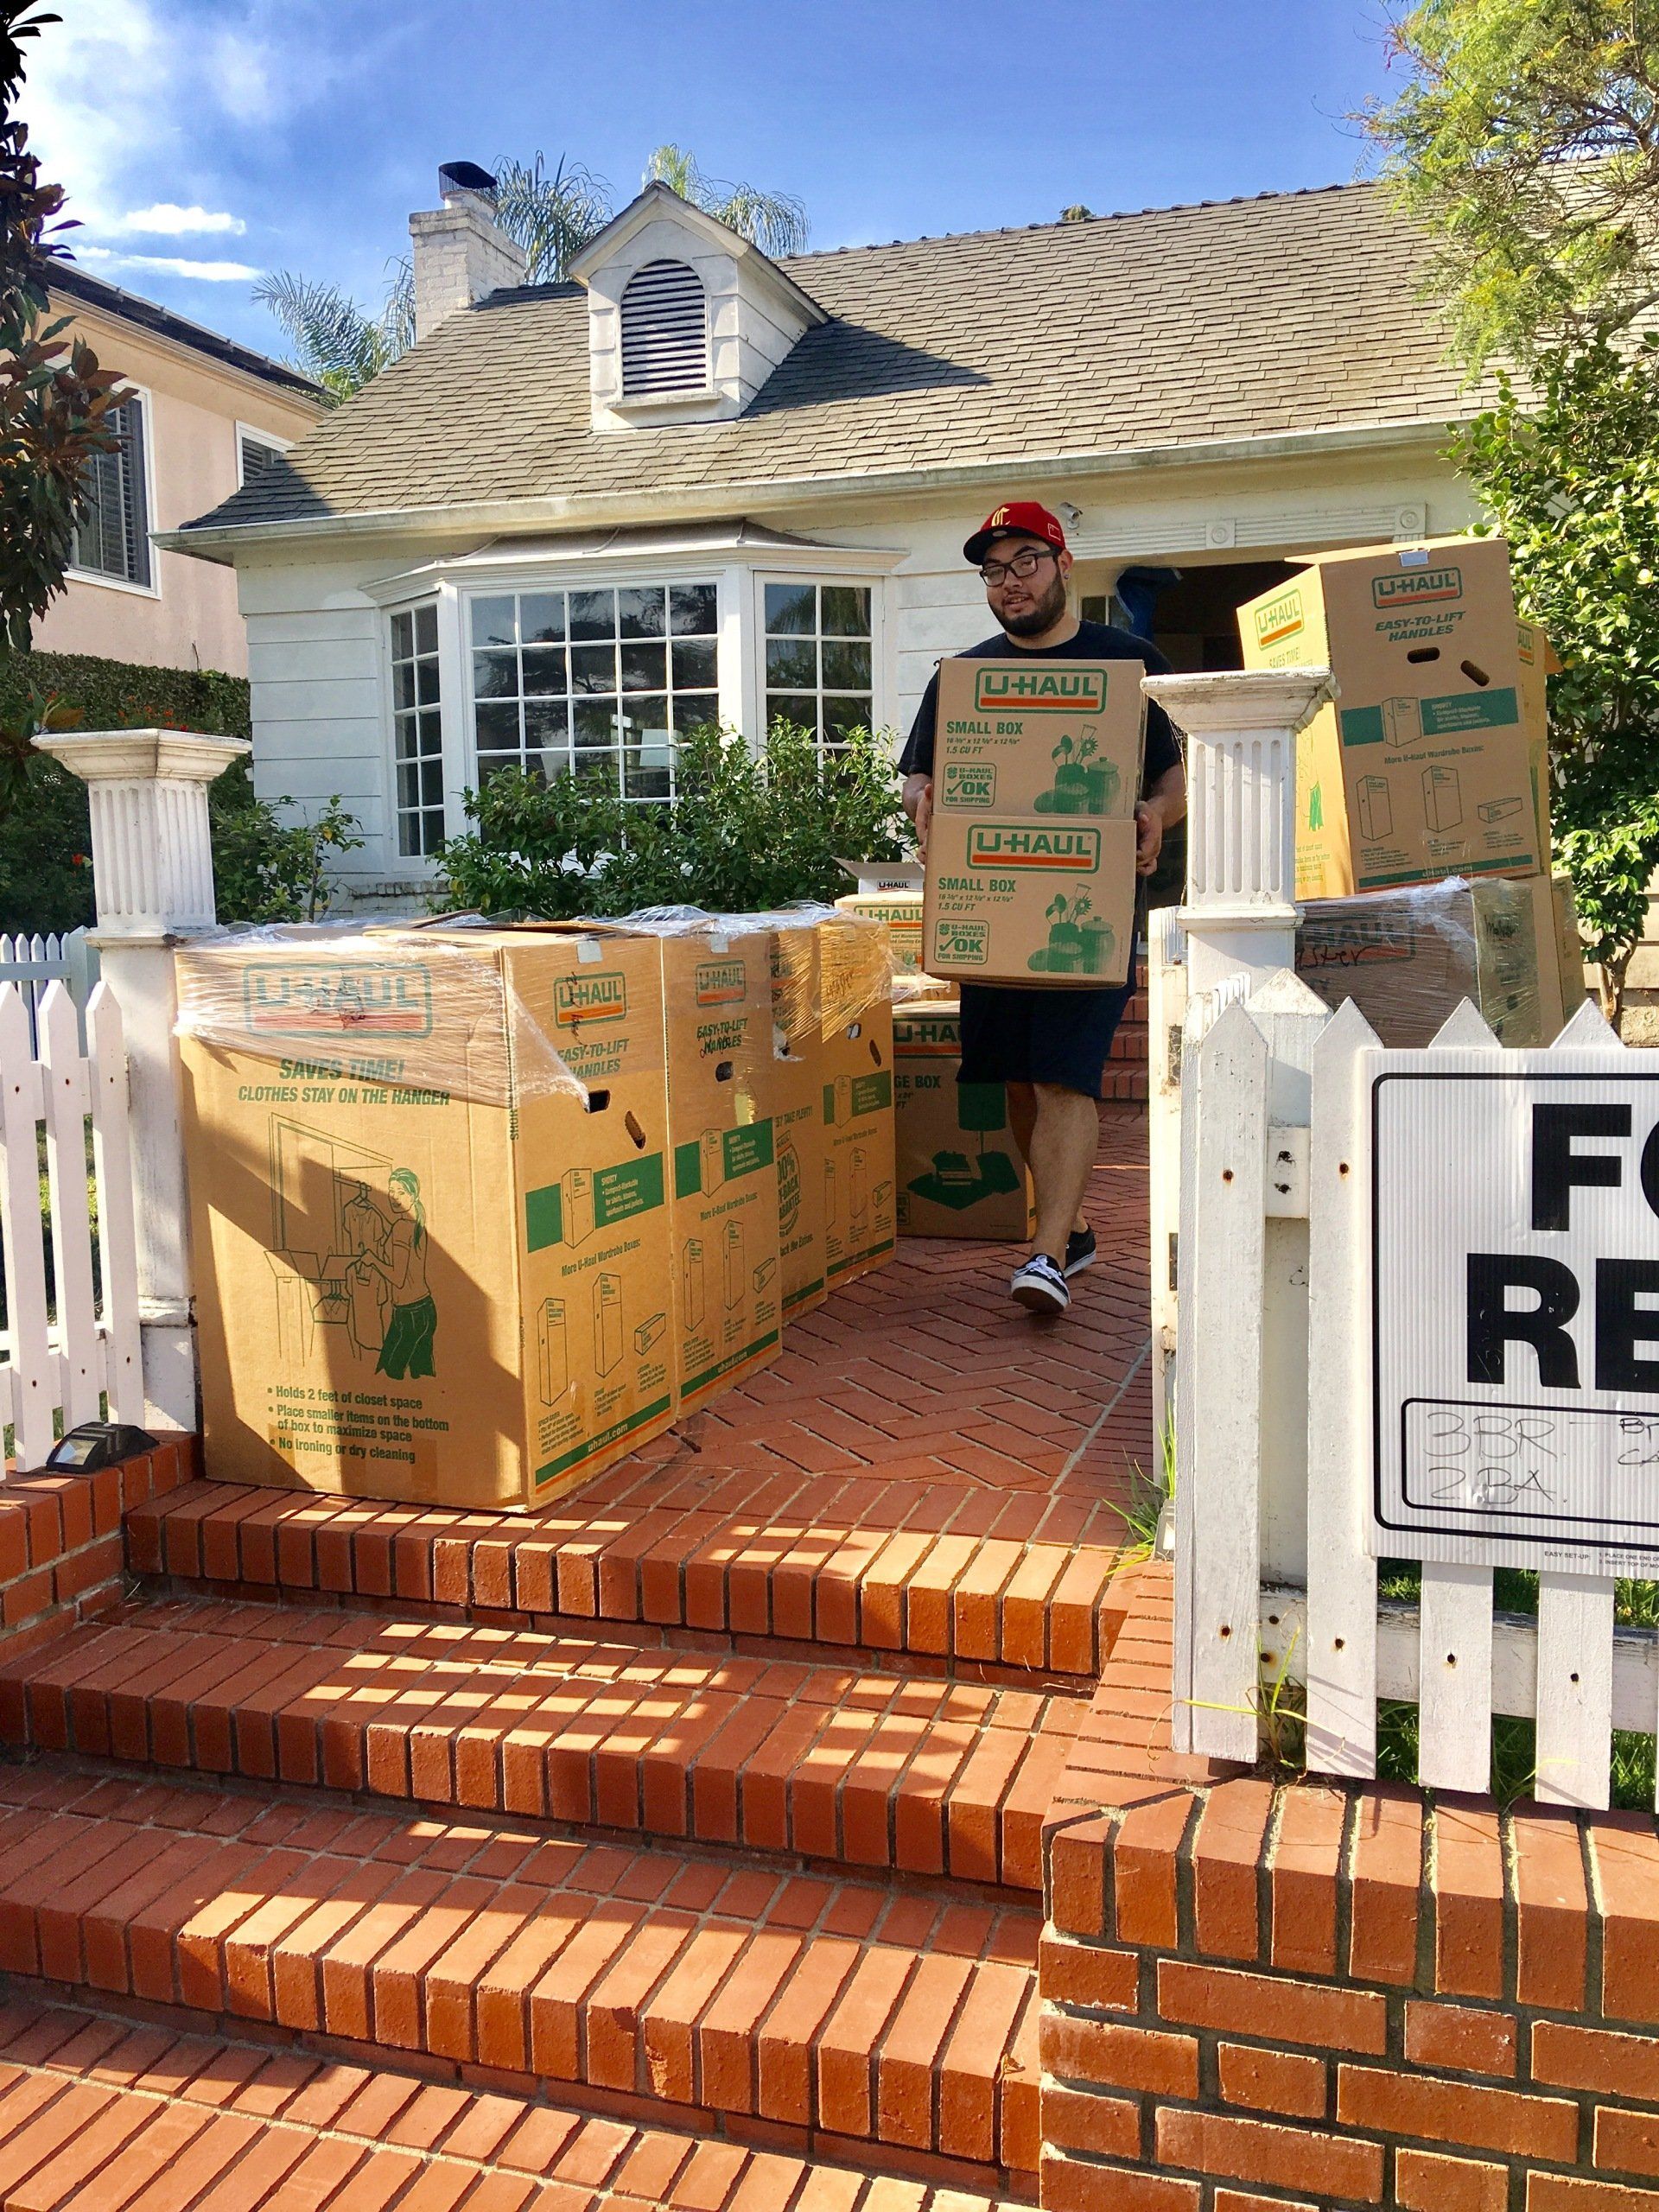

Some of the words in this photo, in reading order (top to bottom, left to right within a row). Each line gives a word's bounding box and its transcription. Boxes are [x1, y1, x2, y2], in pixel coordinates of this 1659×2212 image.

[1378, 573, 1456, 596] U-HAUL
[1258, 598, 1300, 633] U-HAUL
[1376, 611, 1466, 632] EASY-TO-LIFT
[1389, 624, 1453, 642] HANDLES
[984, 675, 1098, 696] U-HAUL
[946, 721, 991, 734] SMALL
[996, 721, 1024, 734] BOX
[962, 781, 990, 796] OK
[976, 831, 1091, 855] U-HAUL
[938, 877, 984, 891] SMALL
[989, 879, 1016, 893] BOX
[954, 938, 983, 953] OK
[698, 967, 743, 991] U-HAUL
[255, 976, 420, 1008] U-HAUL
[559, 980, 622, 1008] U-HAUL
[893, 1024, 963, 1043] U-HA
[279, 1058, 344, 1080] SAVES
[348, 1058, 407, 1082] TIME!
[915, 1075, 941, 1089] BOX
[238, 1085, 299, 1103] CLOTHES
[301, 1087, 335, 1103] STAY
[338, 1087, 357, 1104] ON
[362, 1088, 388, 1105] THE
[391, 1089, 450, 1106] HANGER
[1532, 1103, 1659, 1232] F
[276, 1385, 305, 1400] Holds
[308, 1389, 315, 1400] 2
[318, 1389, 338, 1402] feet
[341, 1391, 352, 1403] of
[354, 1392, 387, 1407] closet
[390, 1395, 423, 1411] space
[277, 1404, 304, 1418] Place
[307, 1406, 344, 1422] smaller
[346, 1410, 374, 1425] items
[378, 1414, 390, 1426] on
[392, 1414, 410, 1427] the
[412, 1416, 449, 1432] bottom
[277, 1418, 289, 1430] of
[291, 1420, 310, 1432] box
[313, 1421, 324, 1433] to
[326, 1423, 378, 1439] maximize
[380, 1428, 412, 1443] space
[588, 1423, 628, 1452] uhaul.com
[278, 1436, 293, 1449] No
[296, 1438, 332, 1456] ironing
[335, 1443, 346, 1454] or
[349, 1442, 366, 1459] dry
[370, 1446, 416, 1465] cleaning
